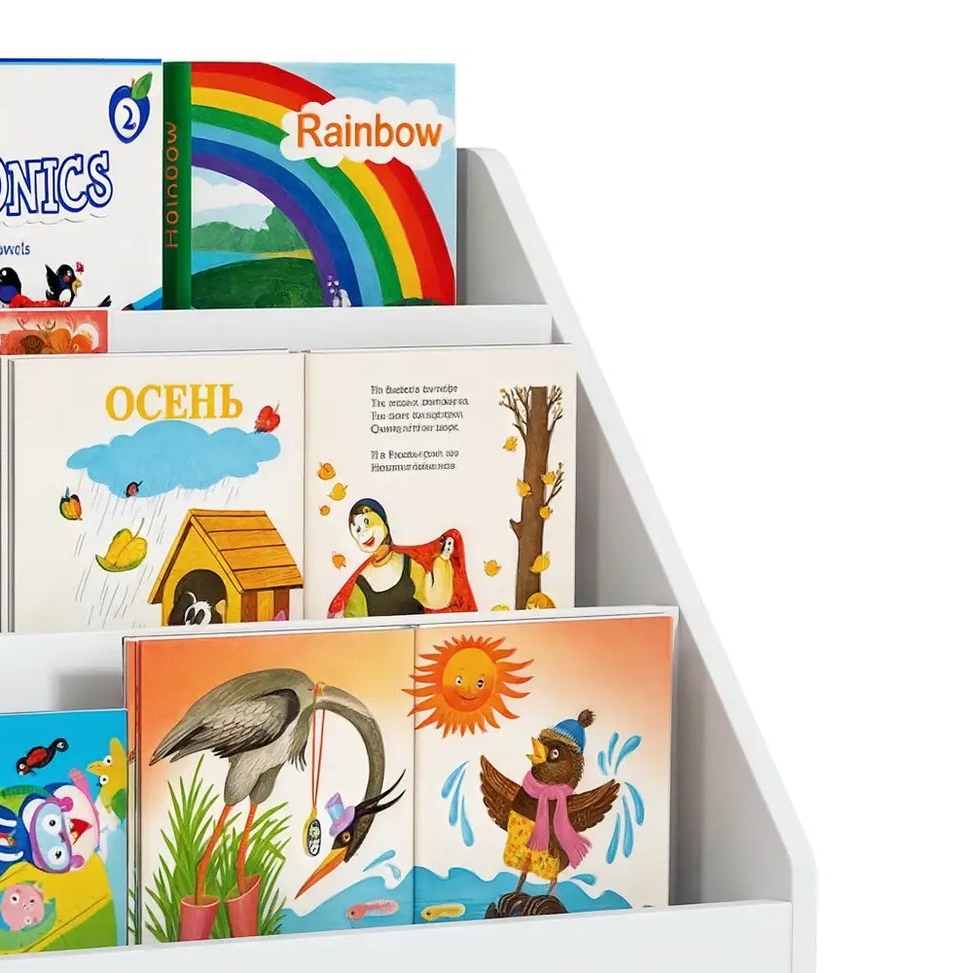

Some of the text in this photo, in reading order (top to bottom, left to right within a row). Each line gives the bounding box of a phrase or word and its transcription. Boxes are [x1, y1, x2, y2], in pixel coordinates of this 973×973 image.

[118, 104, 138, 131] 2
[296, 112, 443, 149] Rainbow
[105, 383, 244, 421] ОСЕНЬ
